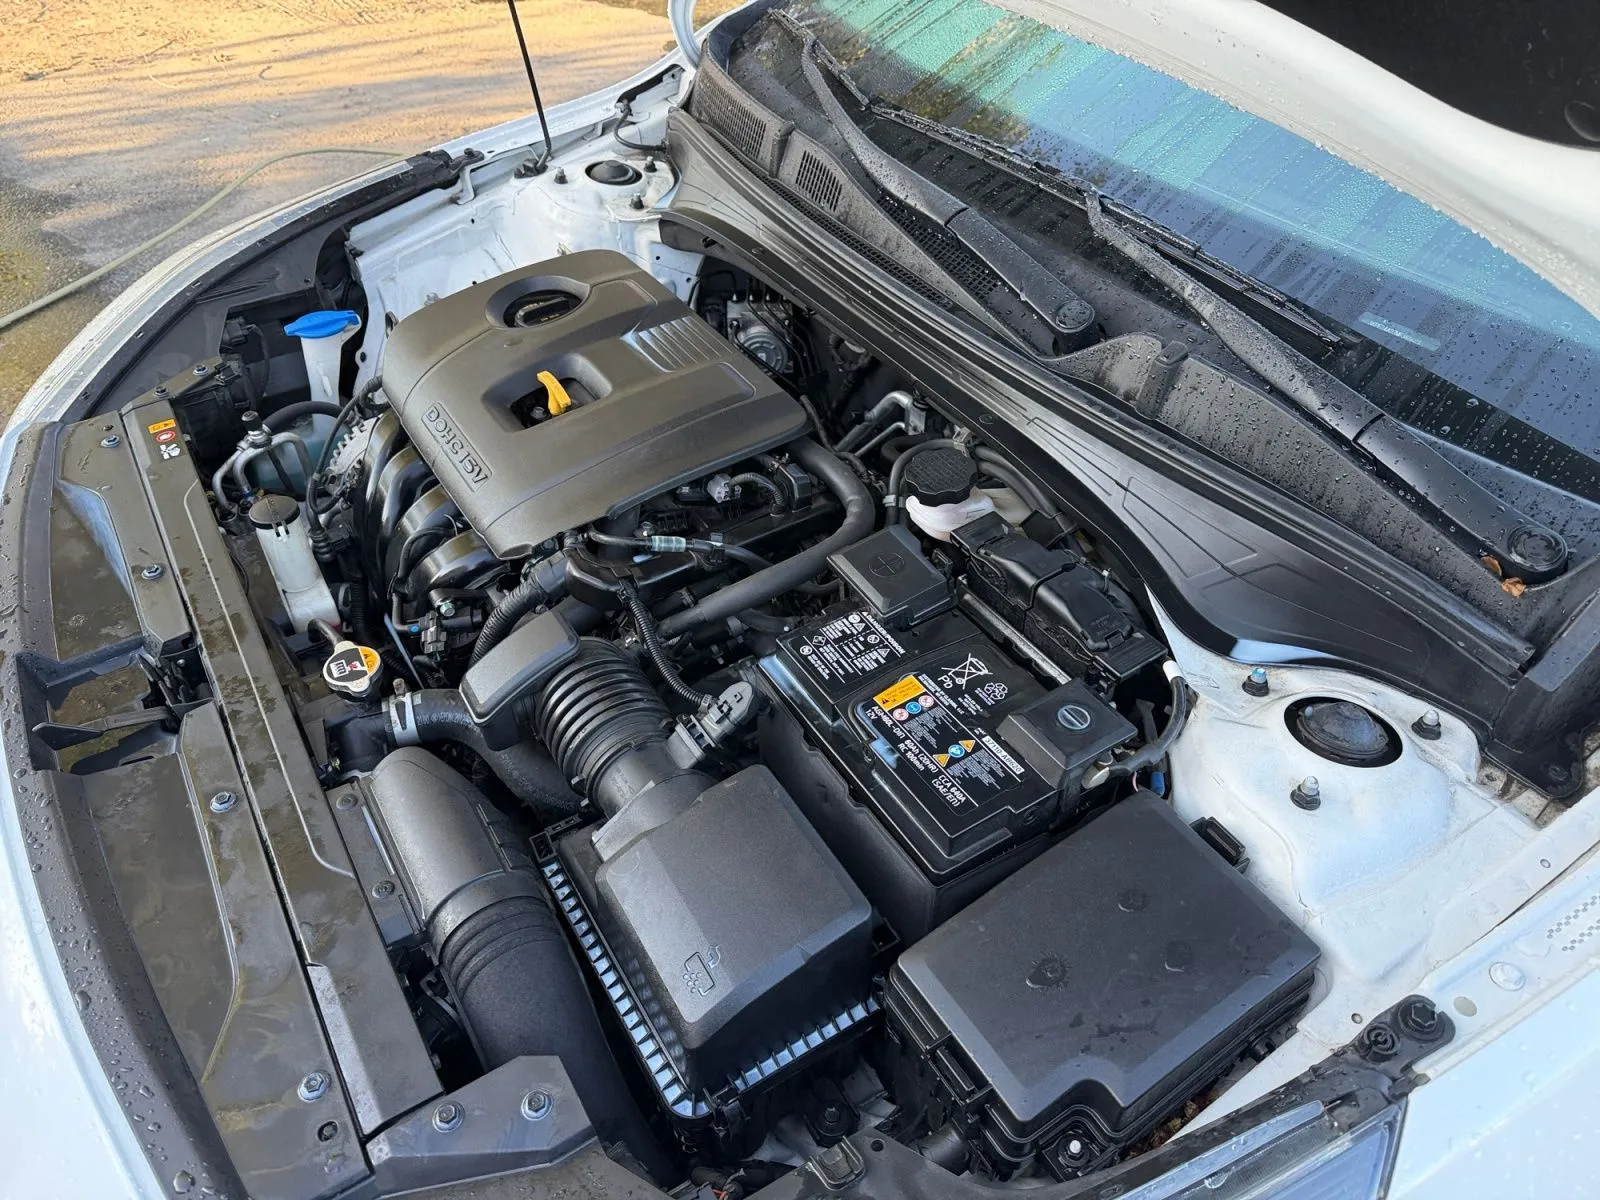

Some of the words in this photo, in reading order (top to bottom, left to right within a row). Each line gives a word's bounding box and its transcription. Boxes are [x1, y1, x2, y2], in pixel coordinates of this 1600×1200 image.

[425, 405, 464, 455] DOHC
[865, 615, 906, 654] DANGER/POISON
[938, 675, 953, 689] Pb
[865, 709, 877, 719] 12V
[897, 744, 907, 753] RC
[904, 752, 926, 771] 100min
[931, 779, 961, 807] (SAE/EN)
[871, 705, 906, 739] AGM60L-DIN
[904, 739, 920, 754] 60Ah
[917, 753, 939, 773] (20HR)
[938, 775, 952, 788] CCA
[949, 788, 966, 803] 640A
